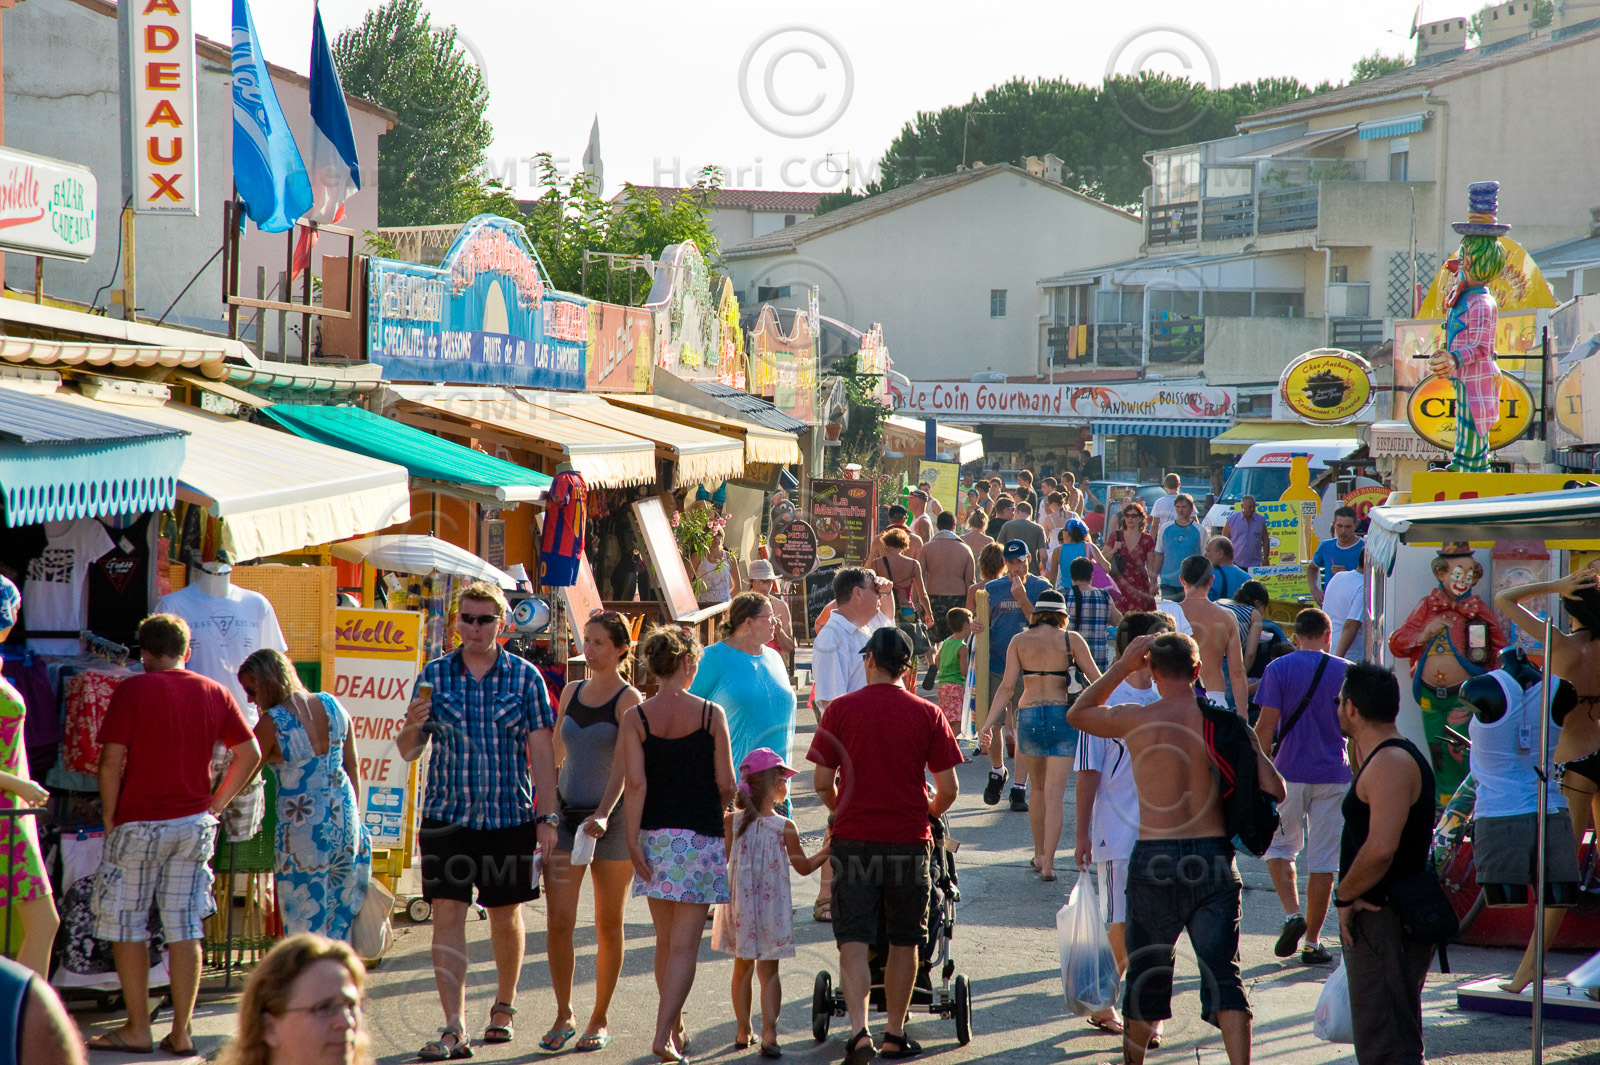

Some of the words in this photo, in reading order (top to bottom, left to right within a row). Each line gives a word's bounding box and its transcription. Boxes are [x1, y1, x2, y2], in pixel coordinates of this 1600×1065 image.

[54, 178, 84, 211] BAZAR
[52, 211, 91, 244] CADEAUX
[383, 325, 425, 357] SPECIALITES
[428, 327, 437, 358] de
[440, 331, 472, 359] POISSONS
[483, 335, 501, 363] FRUITS
[504, 338, 512, 364] de
[515, 339, 525, 365] MER
[534, 342, 549, 369] PLATS
[556, 346, 579, 371] EMPORTER
[1321, 360, 1353, 374] Anthony
[909, 384, 926, 411] Le
[932, 384, 969, 412] Coin
[976, 384, 1061, 414] Gourmand
[1066, 386, 1099, 400] PIZZAS
[1159, 391, 1203, 405] BOISSONS
[1100, 400, 1156, 416] SANDWICHS
[1204, 403, 1236, 416] FRITES
[1295, 397, 1330, 415] Restaurant
[1376, 436, 1413, 451] RESTAURANT
[833, 495, 848, 506] La
[814, 504, 866, 517] Marmite
